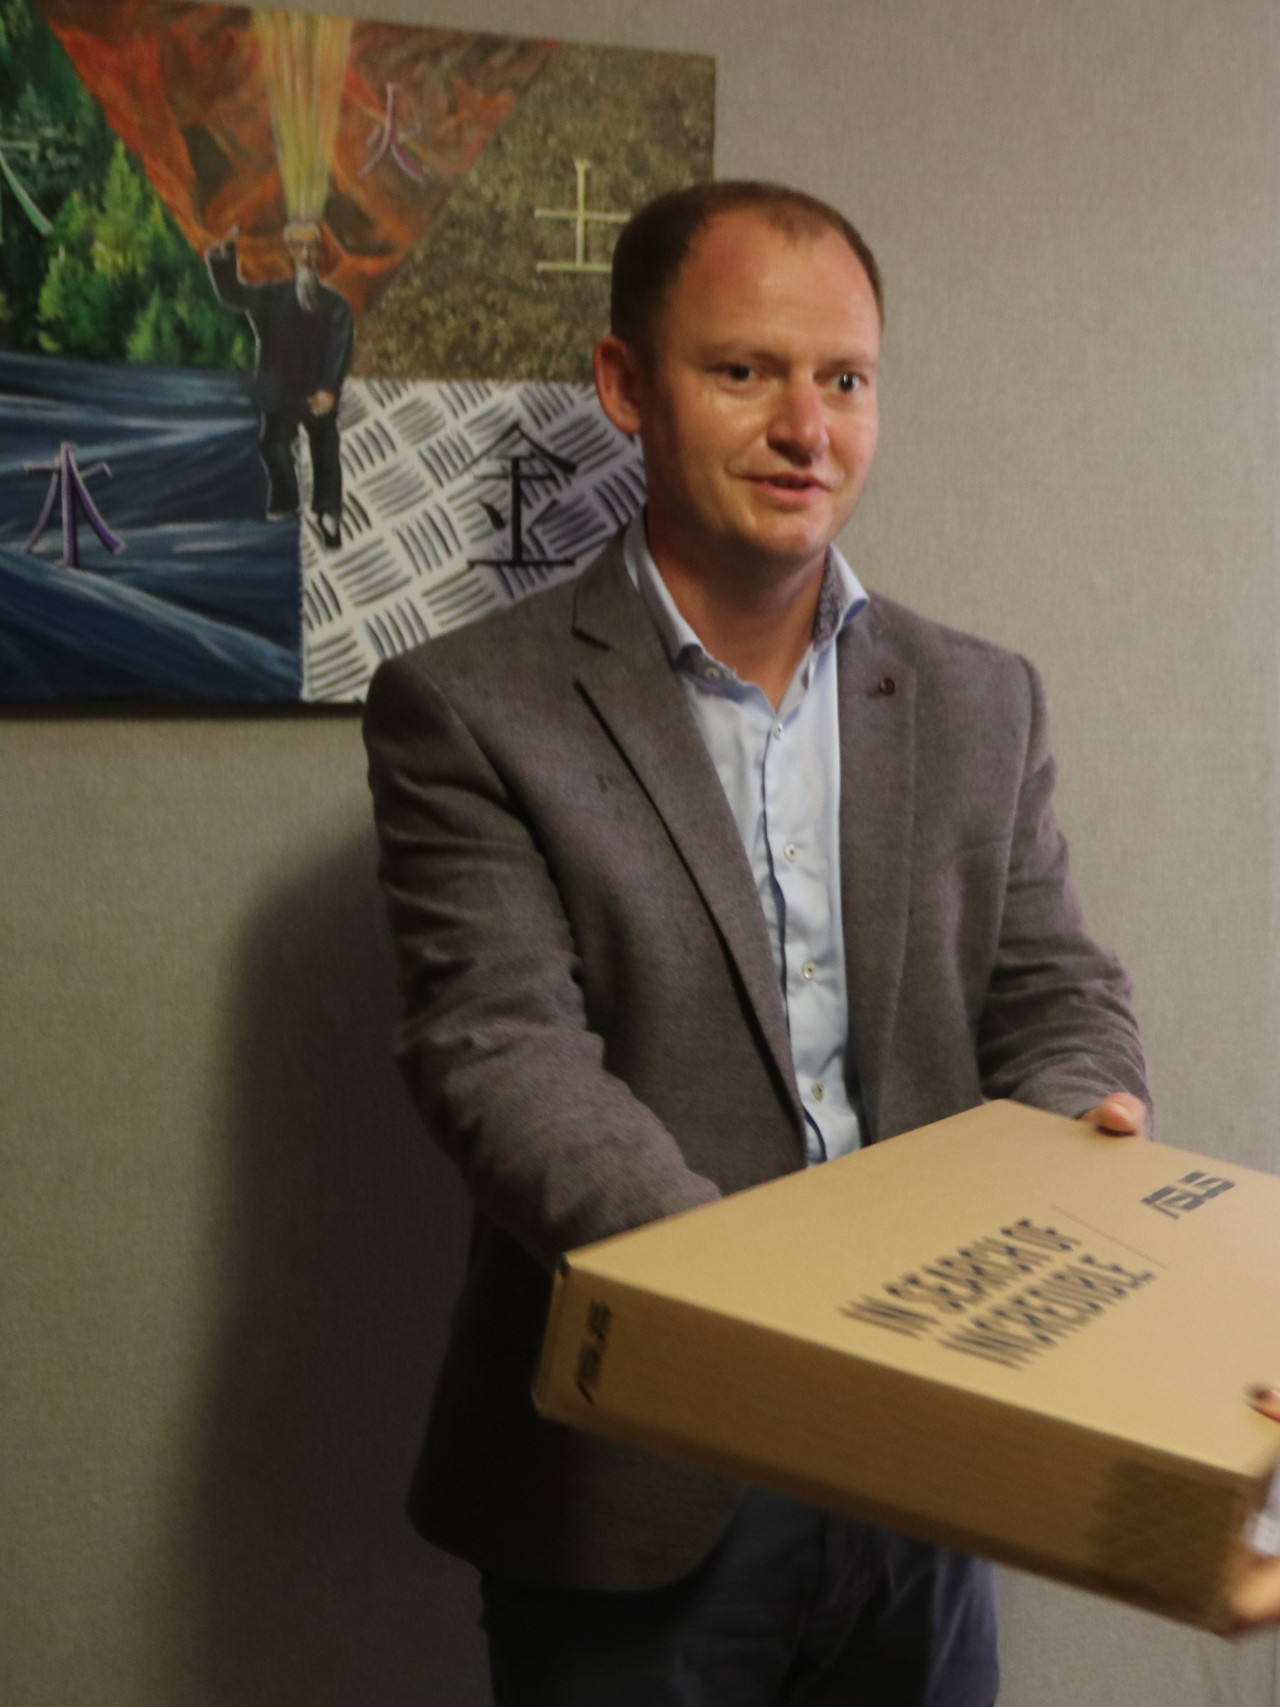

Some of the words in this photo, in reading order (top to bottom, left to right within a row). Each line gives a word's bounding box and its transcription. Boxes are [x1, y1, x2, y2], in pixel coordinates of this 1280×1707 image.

[1140, 1170, 1236, 1220] ASUS
[999, 1217, 1083, 1253] OF
[881, 1235, 1053, 1315] SEARCH
[836, 1294, 943, 1340] IN
